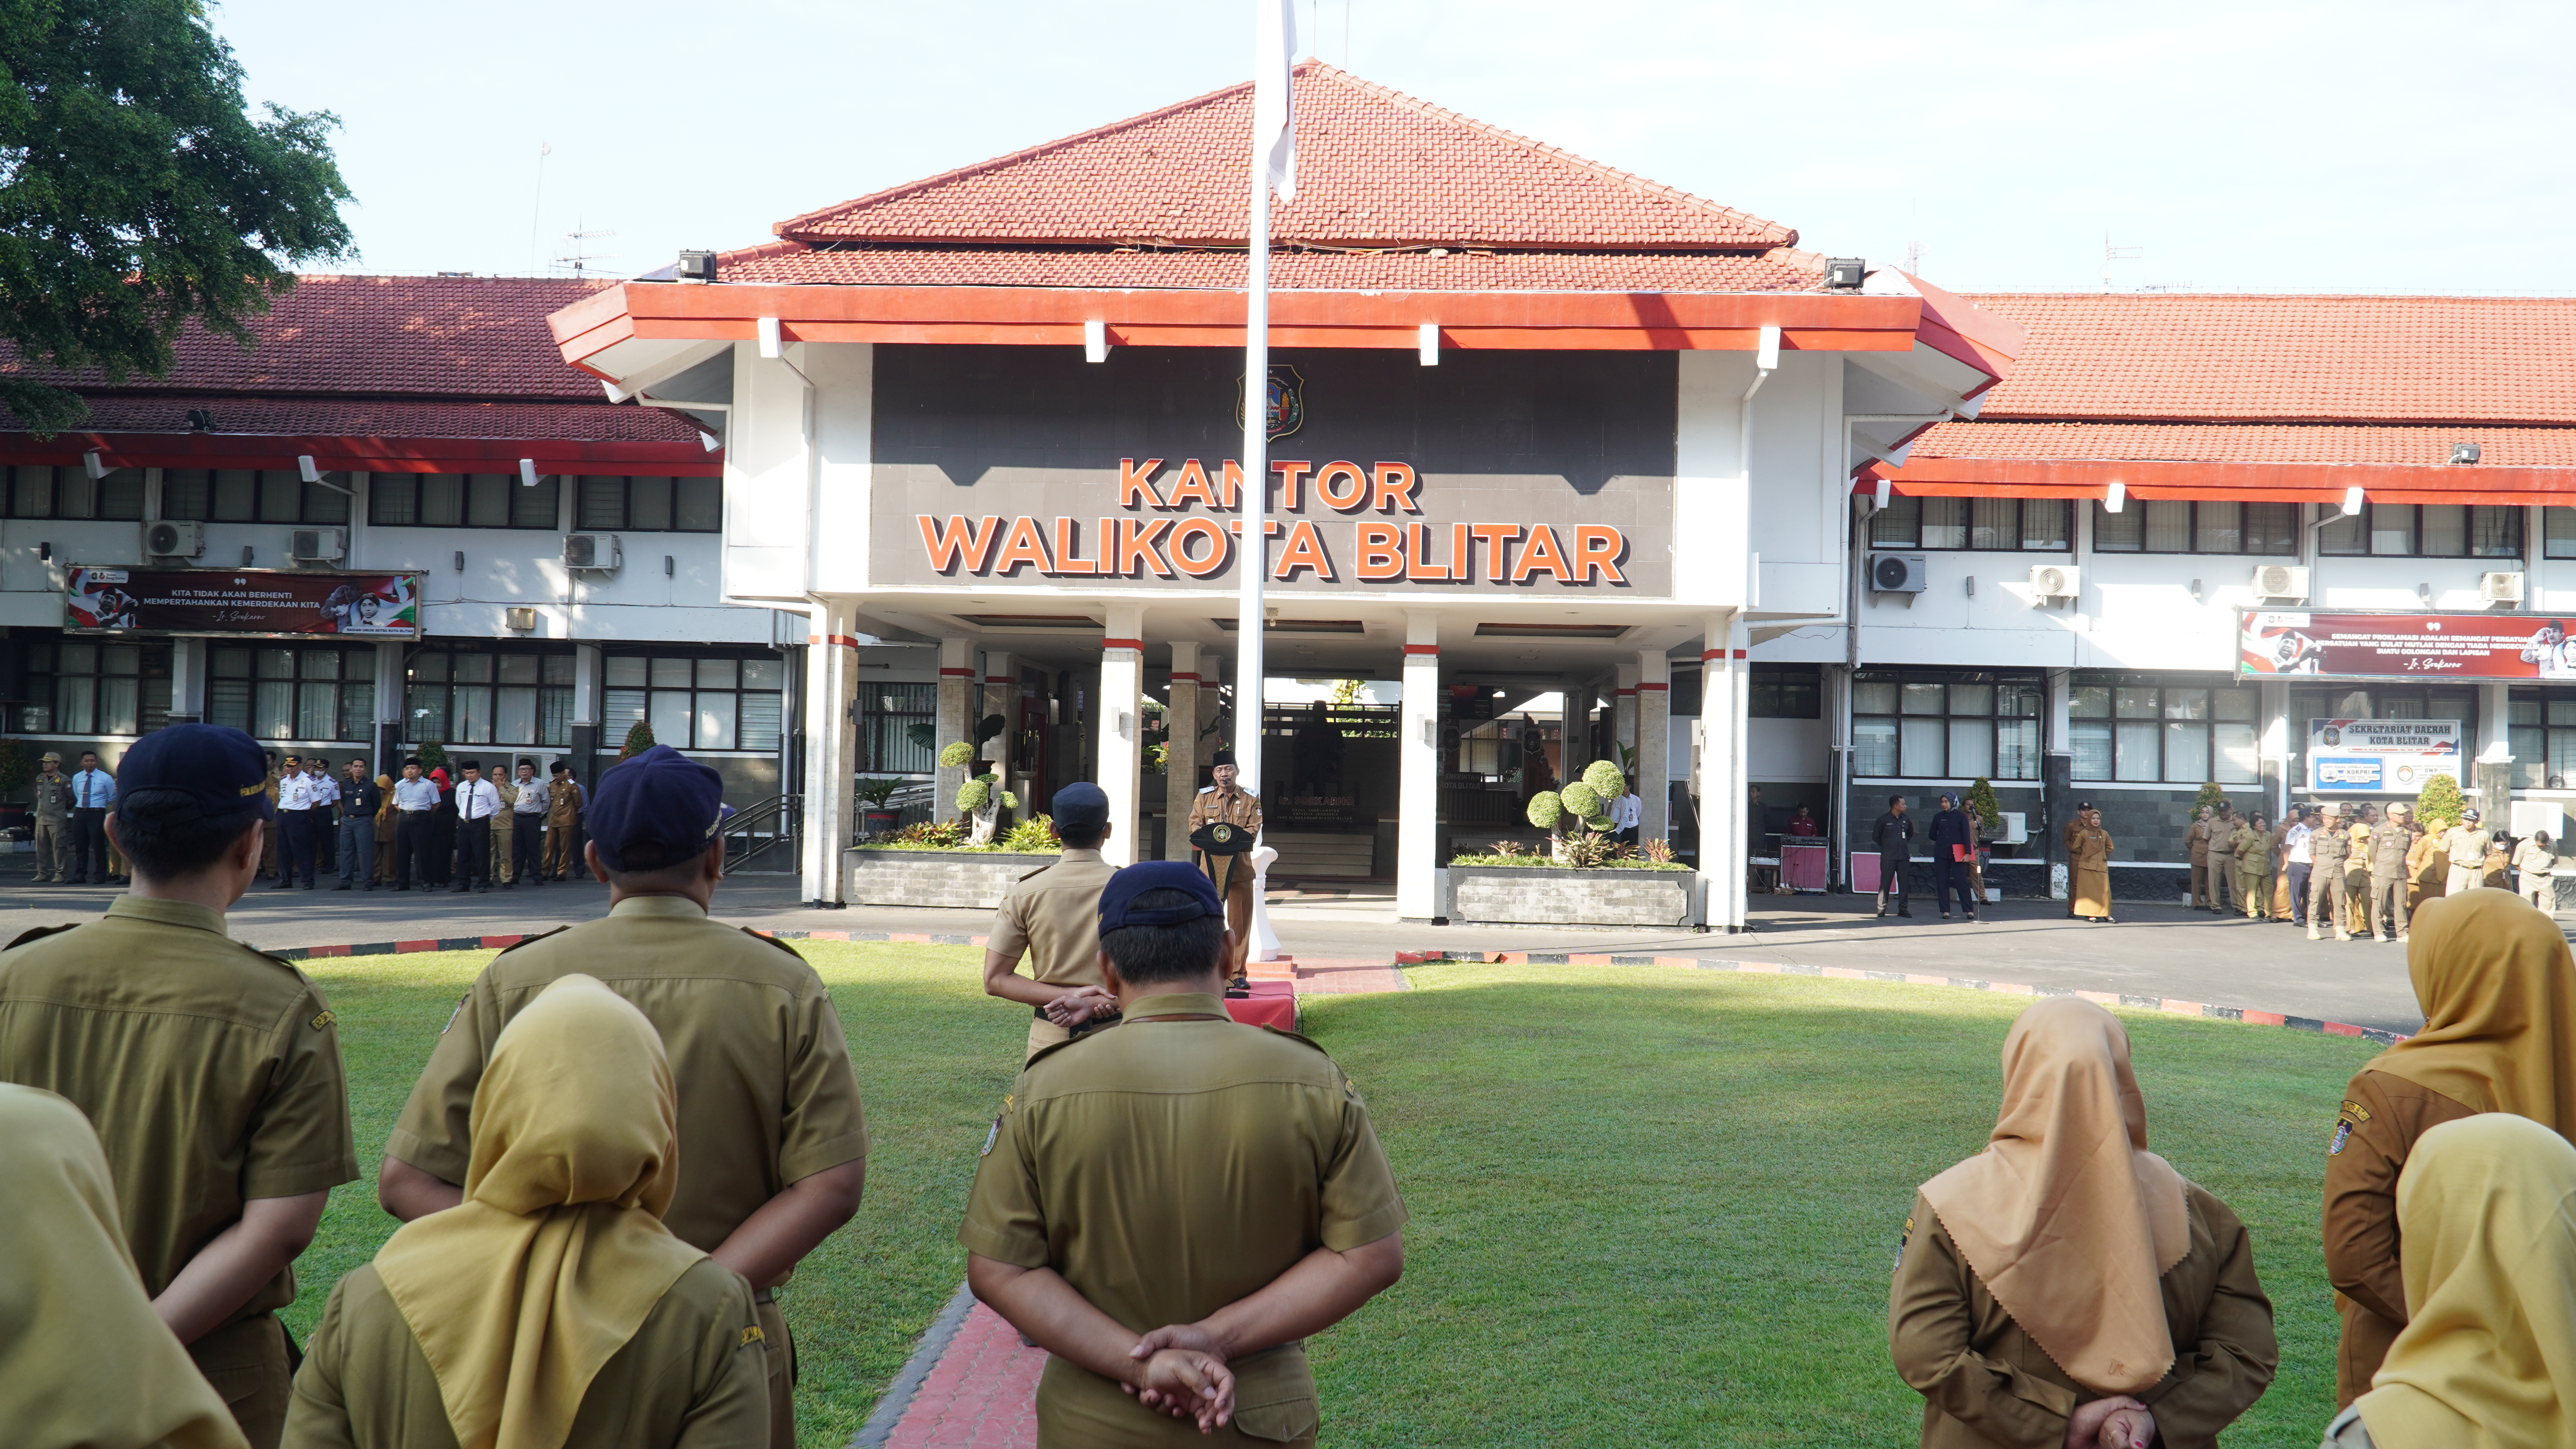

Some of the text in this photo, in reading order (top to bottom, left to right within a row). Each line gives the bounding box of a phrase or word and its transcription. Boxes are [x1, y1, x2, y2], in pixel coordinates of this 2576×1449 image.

[916, 514, 1625, 582] WALIKOA BLITAR
[143, 598, 229, 606] MEMPERTAHANKAN
[231, 600, 298, 608] KEMERDEKAAN
[2348, 725, 2450, 734] SEKRETARIAT DAERAH
[2397, 737, 2430, 745] BLITAR
[1279, 796, 1354, 805] Ir. SOEKARNO
